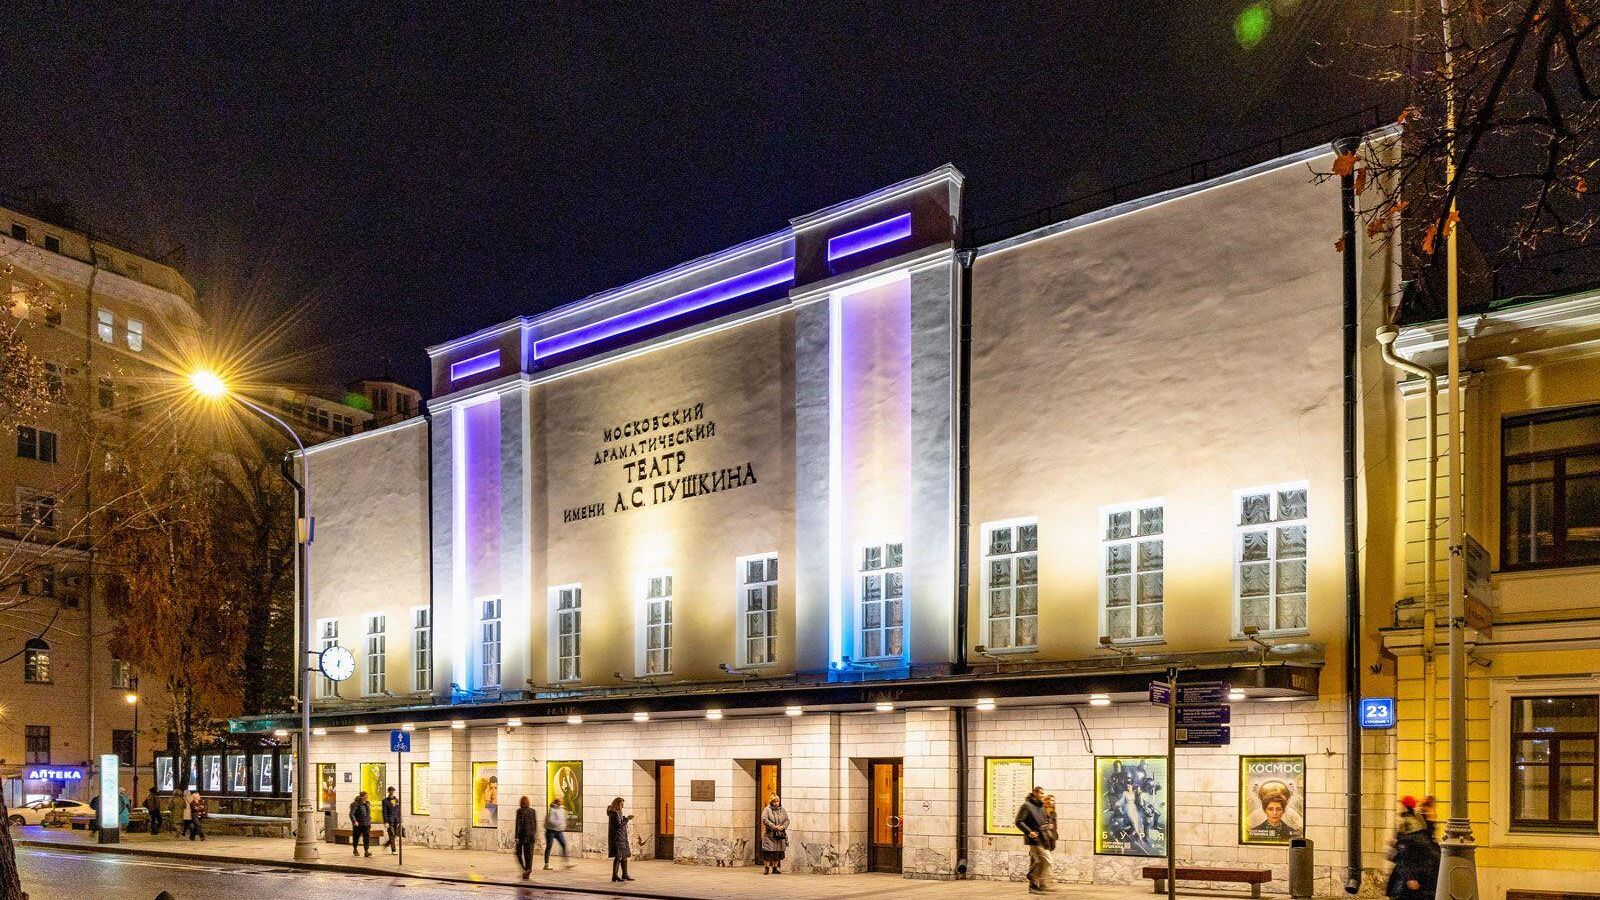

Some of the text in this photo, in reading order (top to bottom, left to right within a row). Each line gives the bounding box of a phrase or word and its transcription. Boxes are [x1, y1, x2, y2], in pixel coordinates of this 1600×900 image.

[603, 403, 704, 442] МОСКОВСКИЙ
[593, 421, 715, 465] ДРАМАТИЧЕСКИЙ
[623, 451, 686, 483] ТЕАТР
[563, 503, 605, 523] ИМЕНИ
[653, 462, 757, 505] ПУШКИНА
[1366, 705, 1388, 718] 23
[29, 769, 81, 779] АПТЕКА
[1248, 763, 1301, 773] КОСМОС
